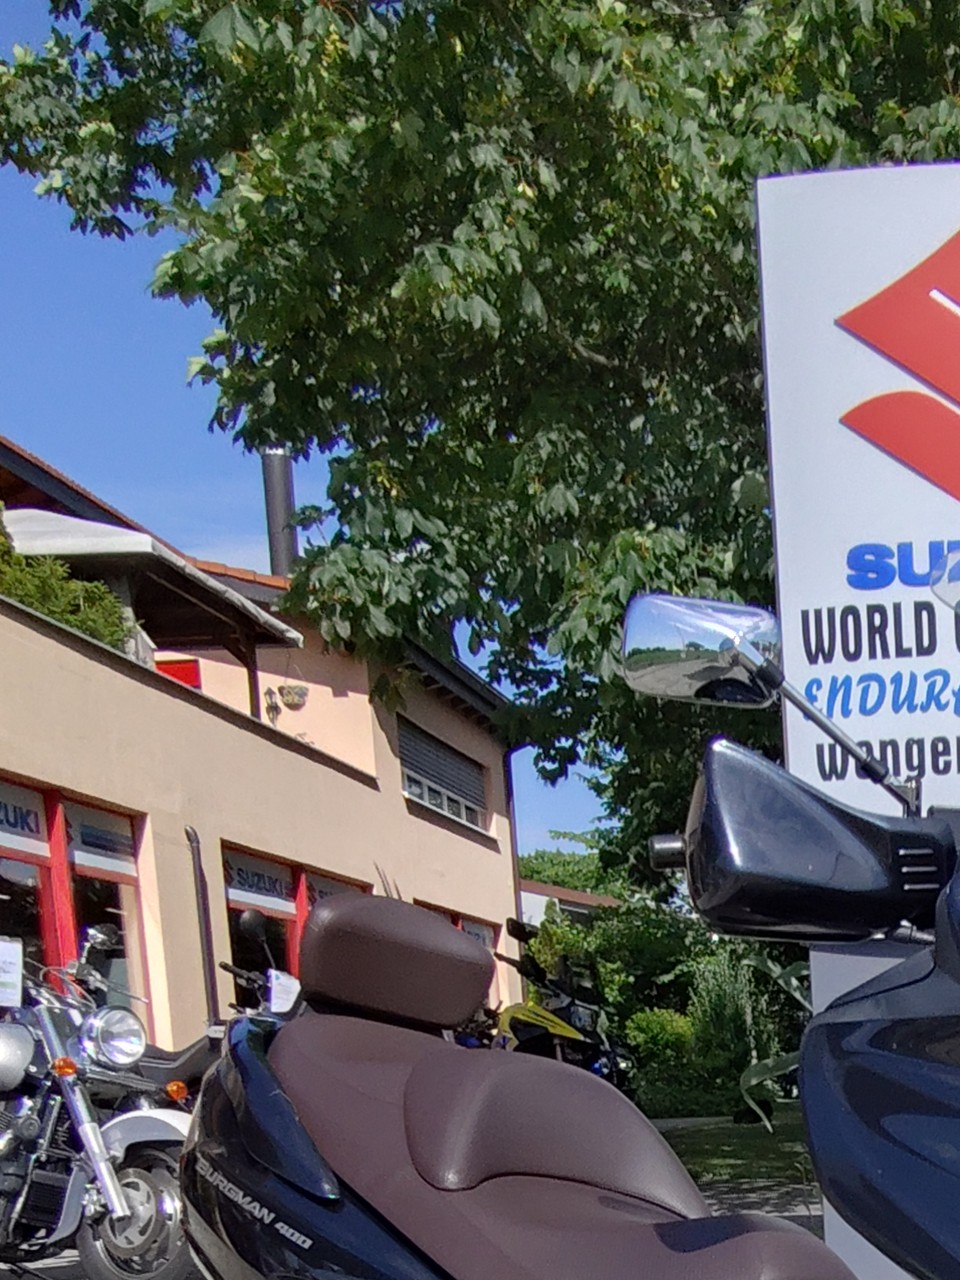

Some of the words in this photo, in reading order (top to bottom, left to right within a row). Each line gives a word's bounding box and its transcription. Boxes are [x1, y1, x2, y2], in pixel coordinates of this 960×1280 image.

[801, 601, 937, 665] WORLD
[236, 867, 284, 896] SUZUKI
[195, 1151, 276, 1224] BURGMAN
[274, 1221, 314, 1250] 400
